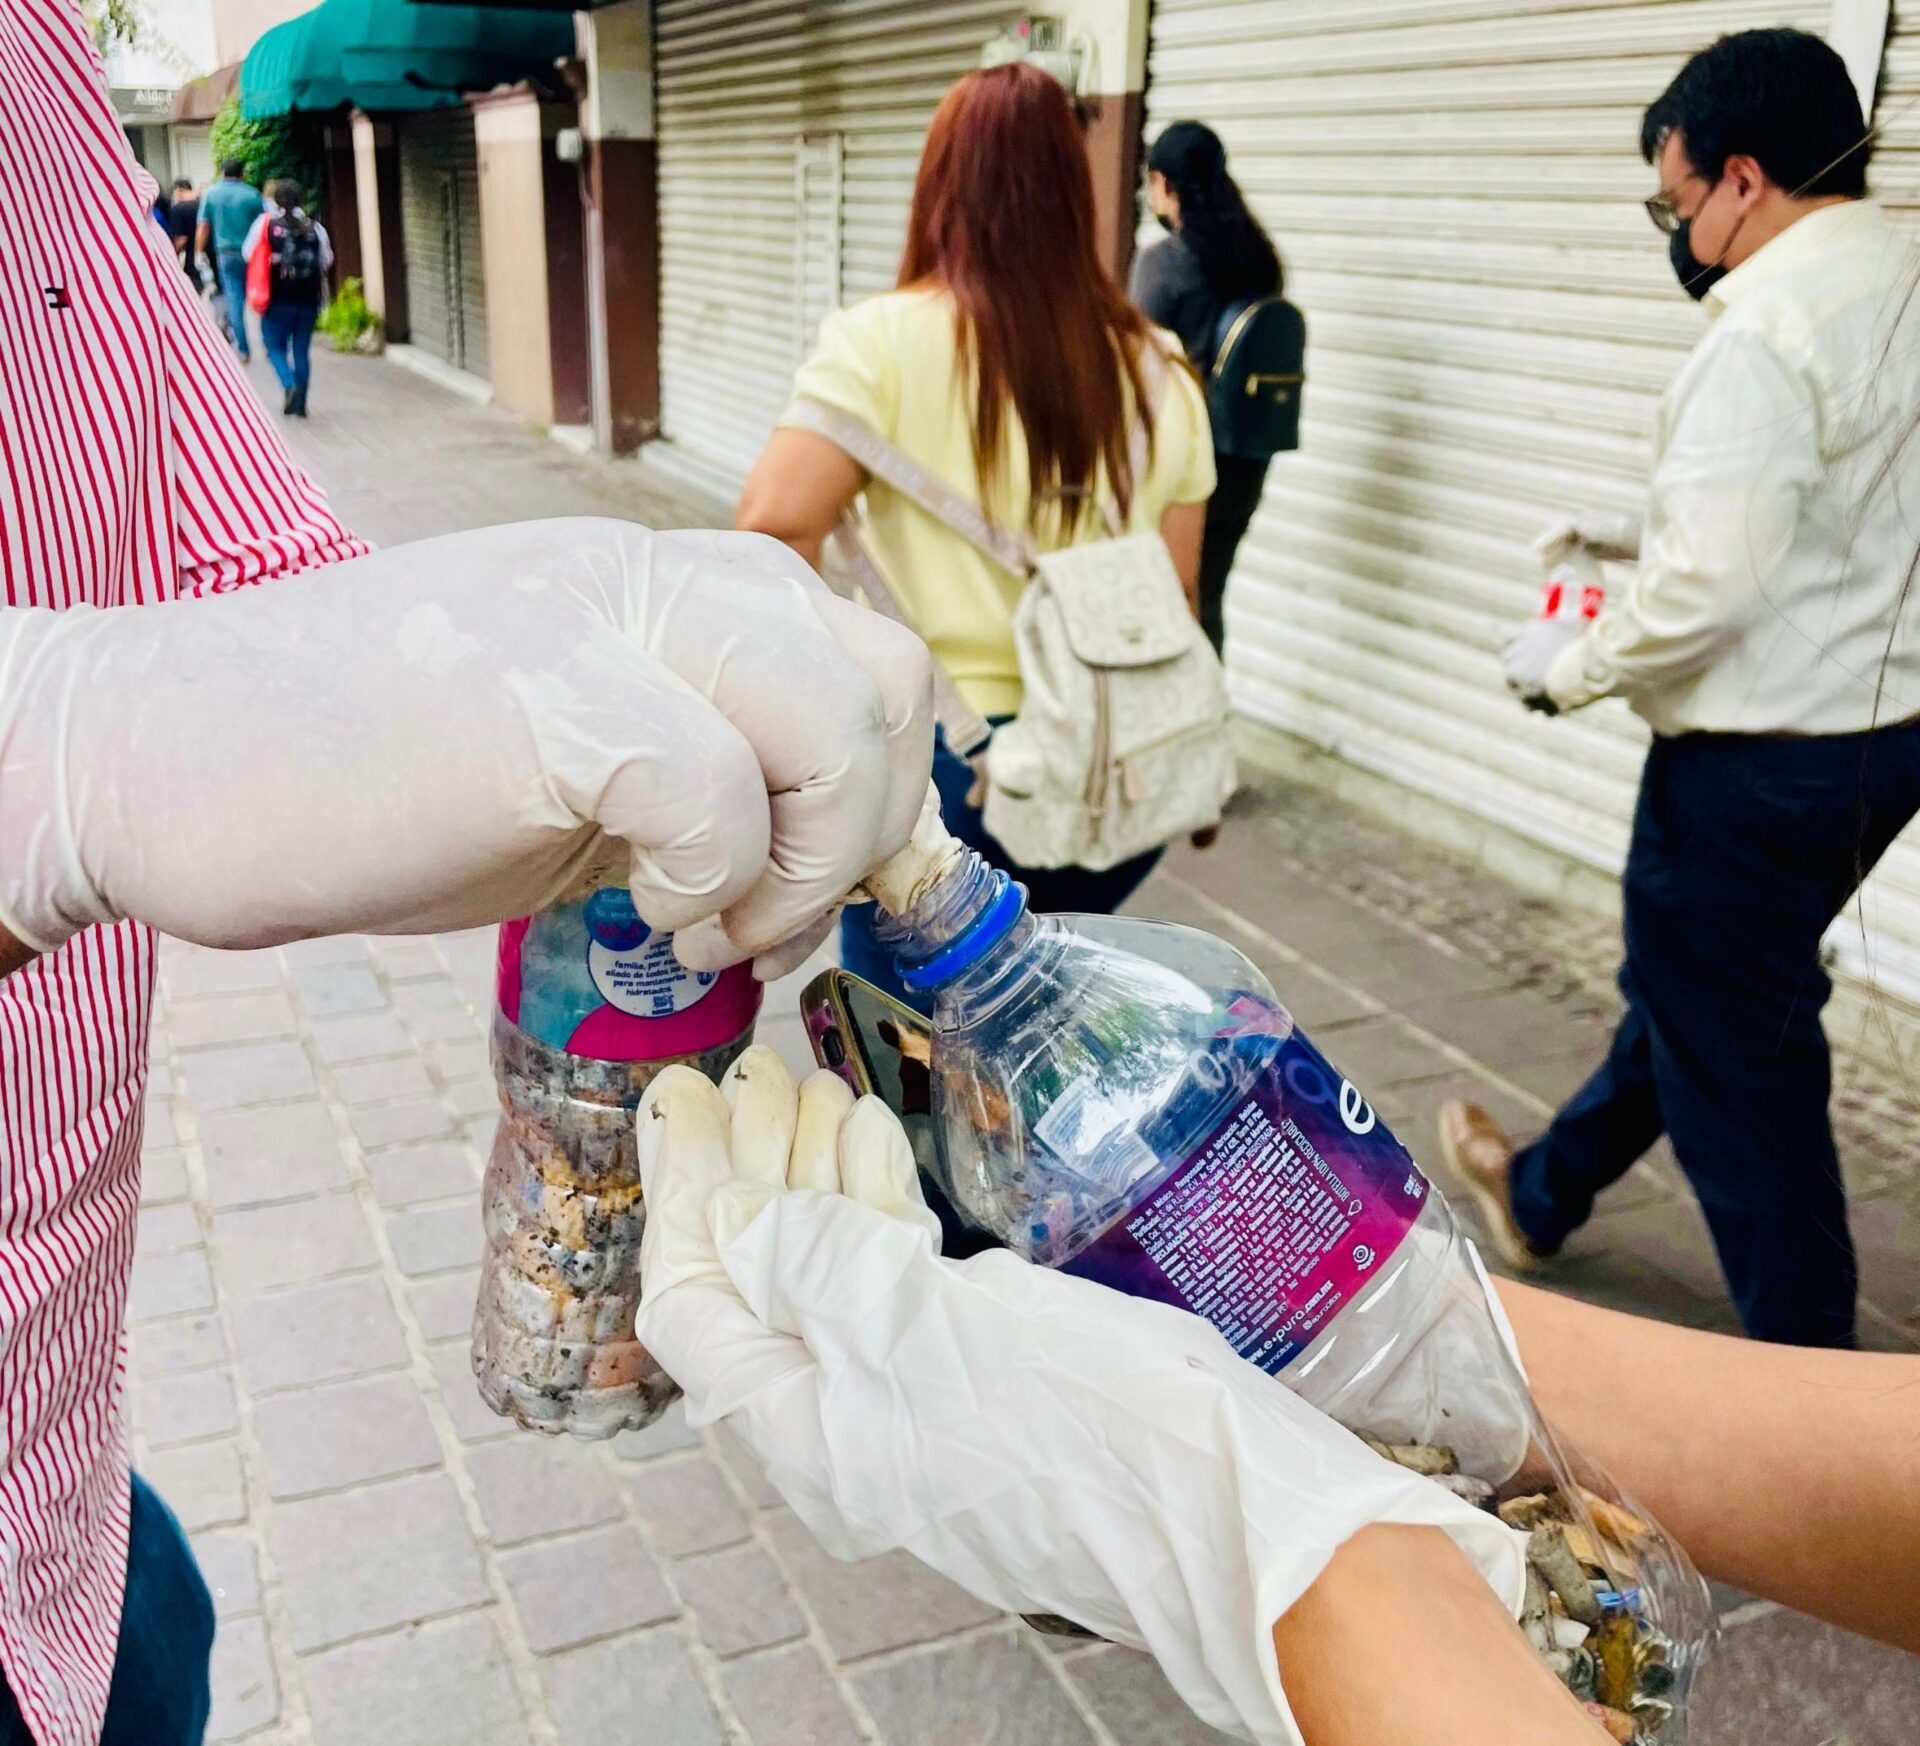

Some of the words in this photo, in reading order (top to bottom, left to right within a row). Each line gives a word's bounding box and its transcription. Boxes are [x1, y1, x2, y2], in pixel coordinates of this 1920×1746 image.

[605, 968, 631, 977] aliado
[633, 969, 644, 978] de
[645, 969, 668, 977] todos
[614, 960, 646, 970] familia,
[647, 960, 661, 970] por
[636, 973, 686, 986] mantenerlos
[1340, 1079, 1374, 1134] e
[1205, 1157, 1221, 1173] Santa
[1235, 1124, 1249, 1138] Torre
[1251, 1108, 1263, 1121] Piso
[1228, 1157, 1247, 1178] MARCA
[1311, 1154, 1329, 1176] 100%
[1126, 1216, 1144, 1232] Hecho
[1174, 1158, 1206, 1188] Responsable
[1325, 1173, 1349, 1201] BOTELLA
[1158, 1216, 1174, 1230] Santa
